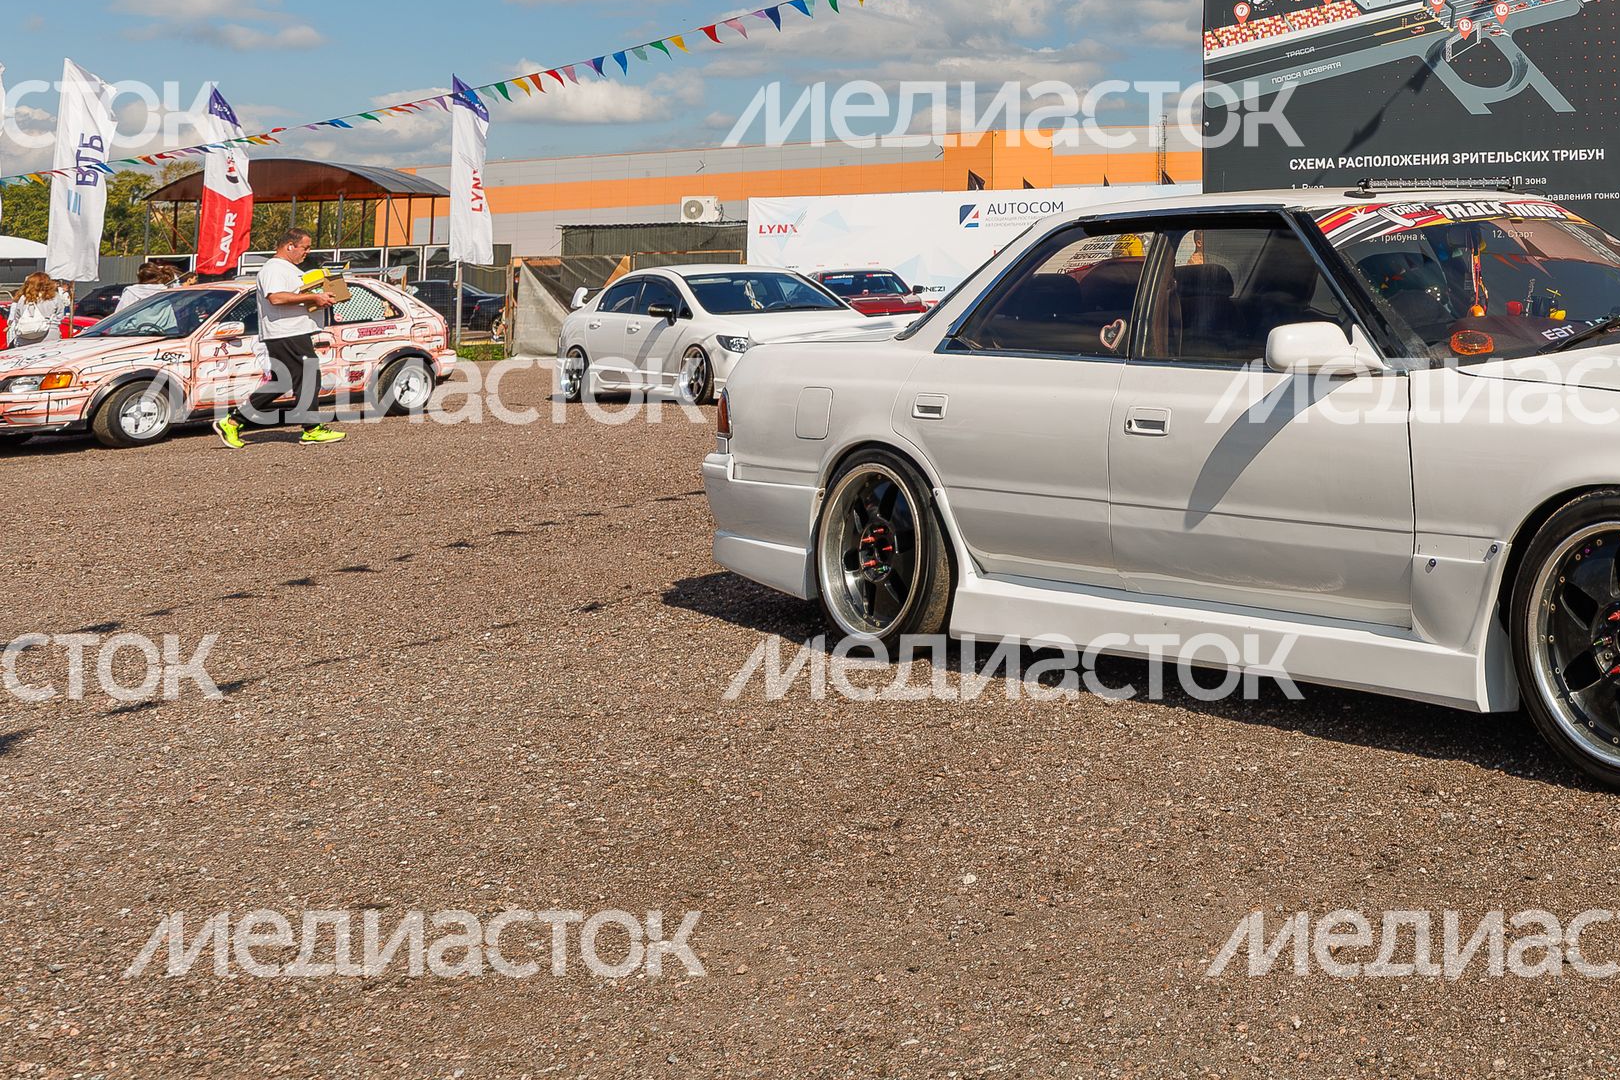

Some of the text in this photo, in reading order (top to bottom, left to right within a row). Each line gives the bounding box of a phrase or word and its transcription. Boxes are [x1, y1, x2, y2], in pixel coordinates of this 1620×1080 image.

[1285, 46, 1316, 58] ТРАССА
[1271, 61, 1342, 84] ПОЛОСА ВОЗВРАТА
[76, 132, 105, 187] ВТБ
[1289, 148, 1605, 170] СХЕМА РАСПОЛОЖЕНИЯ ЗРИТЕЛЬСКИХ ТРИБУН
[1525, 177, 1547, 185] зона
[987, 201, 1064, 215] AUTOCOM
[1394, 203, 1430, 215] DRIFT
[1434, 201, 1569, 220] TRACK MODE
[759, 223, 800, 235] LYNX
[1492, 229, 1534, 239] 12. Старт
[216, 212, 238, 267] LAVR
